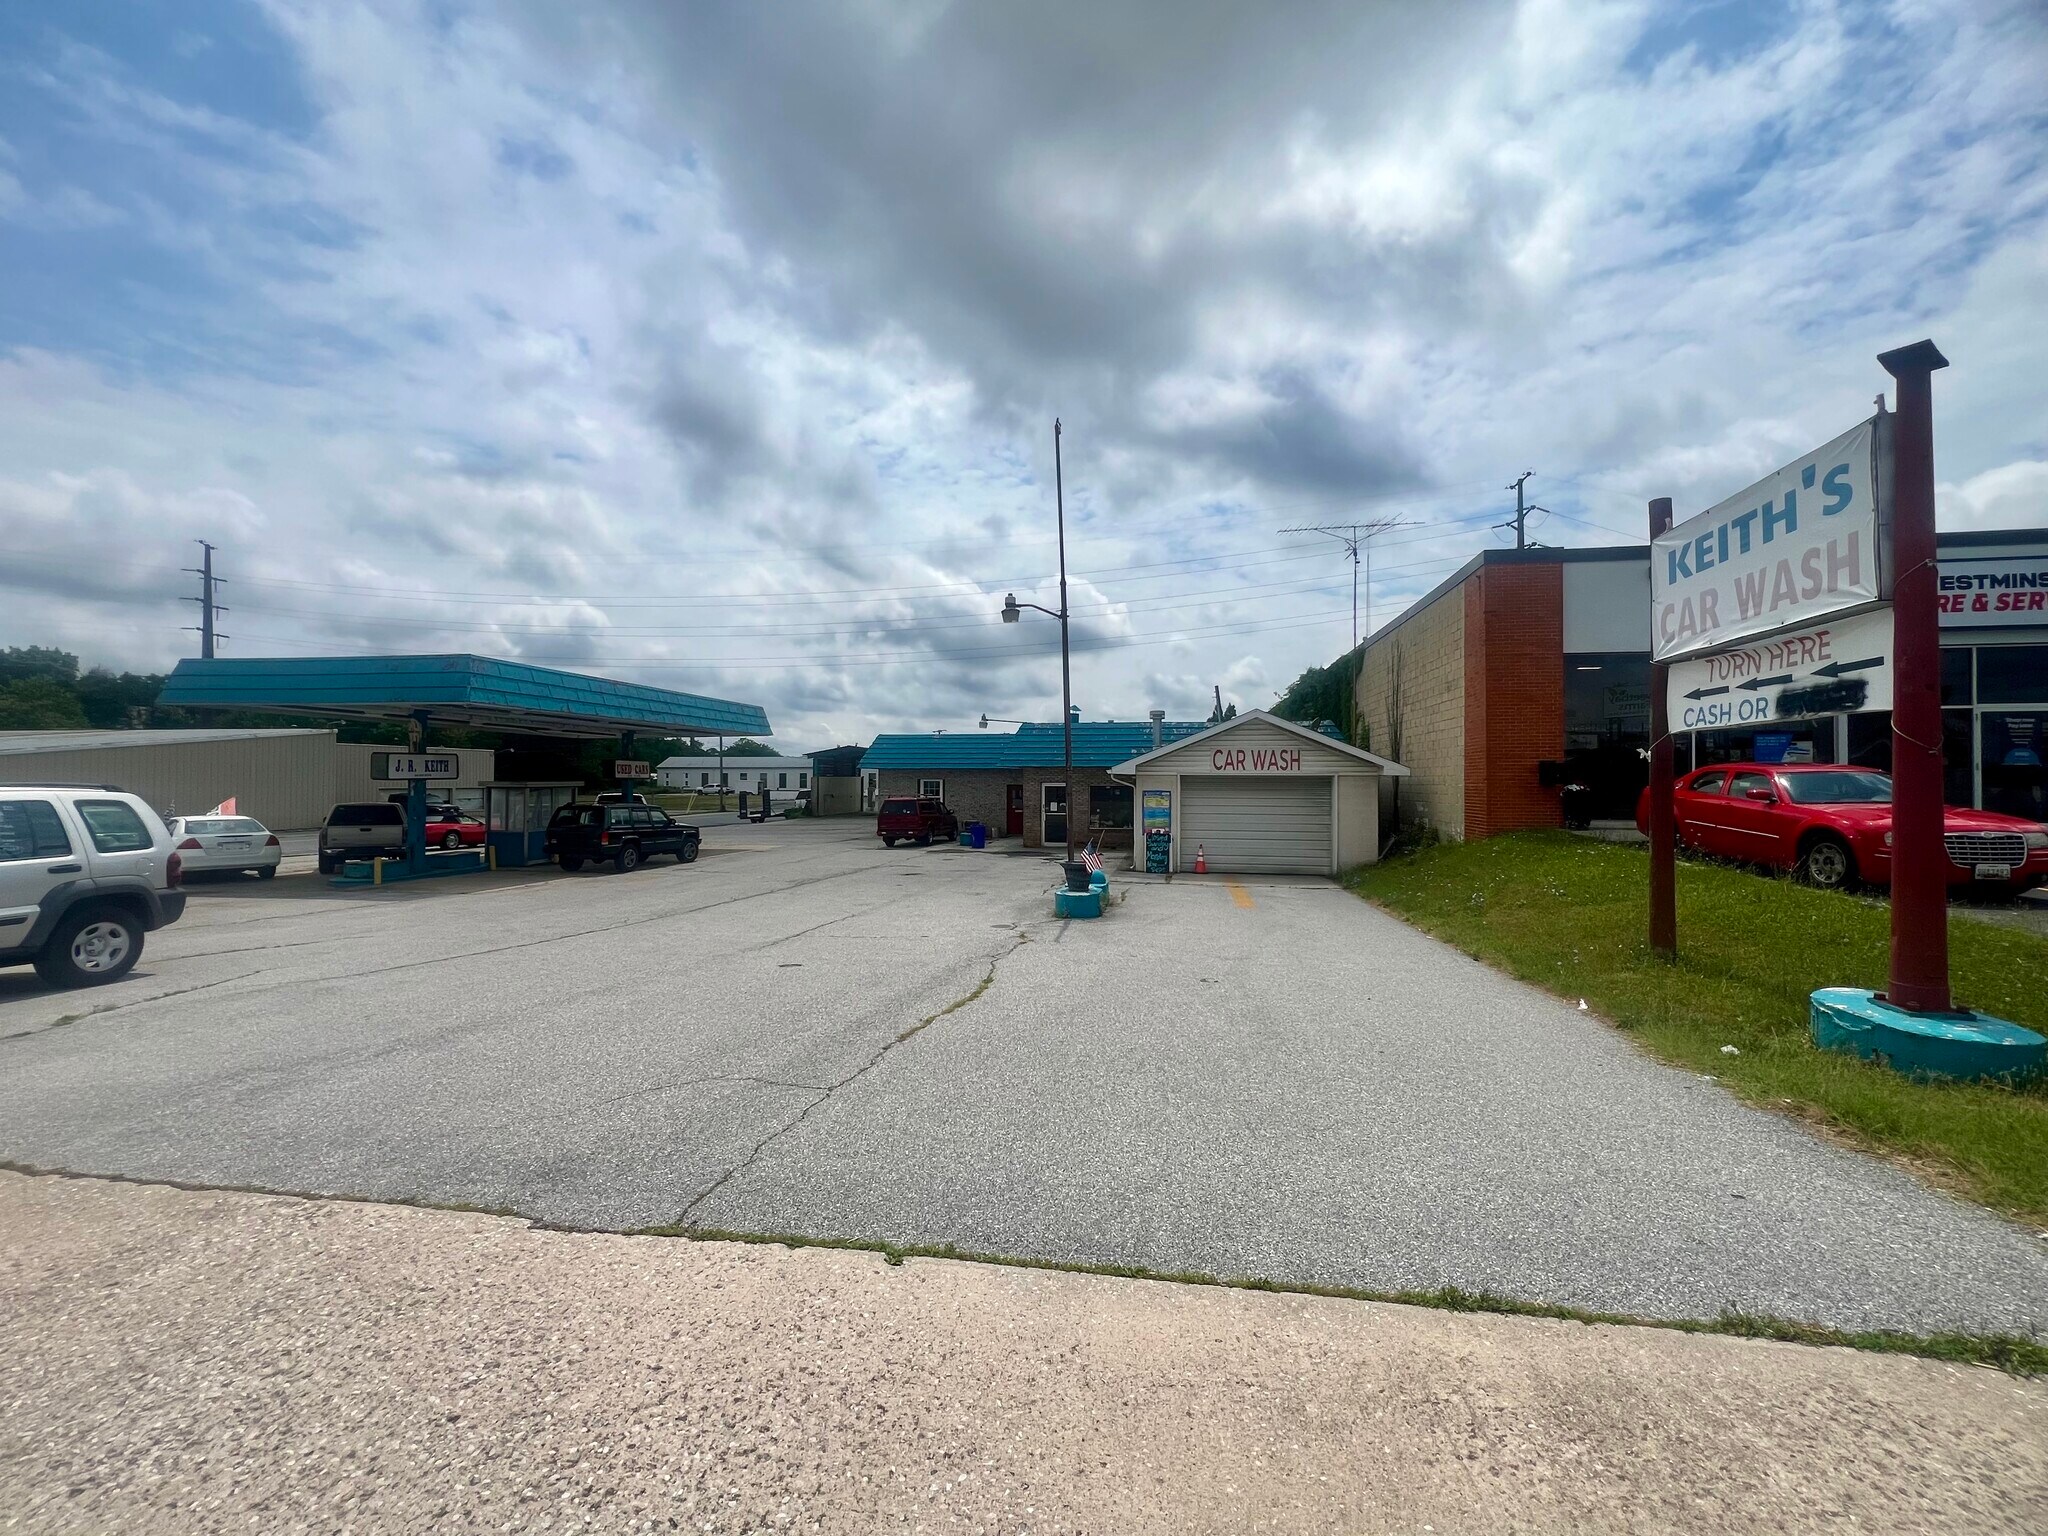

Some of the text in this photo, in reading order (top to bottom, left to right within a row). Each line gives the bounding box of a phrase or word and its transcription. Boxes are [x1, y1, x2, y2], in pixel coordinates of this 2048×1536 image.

[1668, 463, 1853, 585] KEITH'S
[1660, 530, 1861, 643] CAR WASH
[1940, 572, 2048, 591] ESTMINS
[1938, 592, 2048, 613] RE & SER
[1705, 630, 1832, 682] TURN HERE
[1683, 702, 1732, 728] CASH
[1738, 697, 1769, 721] OR
[395, 759, 449, 772] J. R. KEITH
[617, 764, 649, 774] USED CARS
[1213, 749, 1301, 771] CAR WASH
